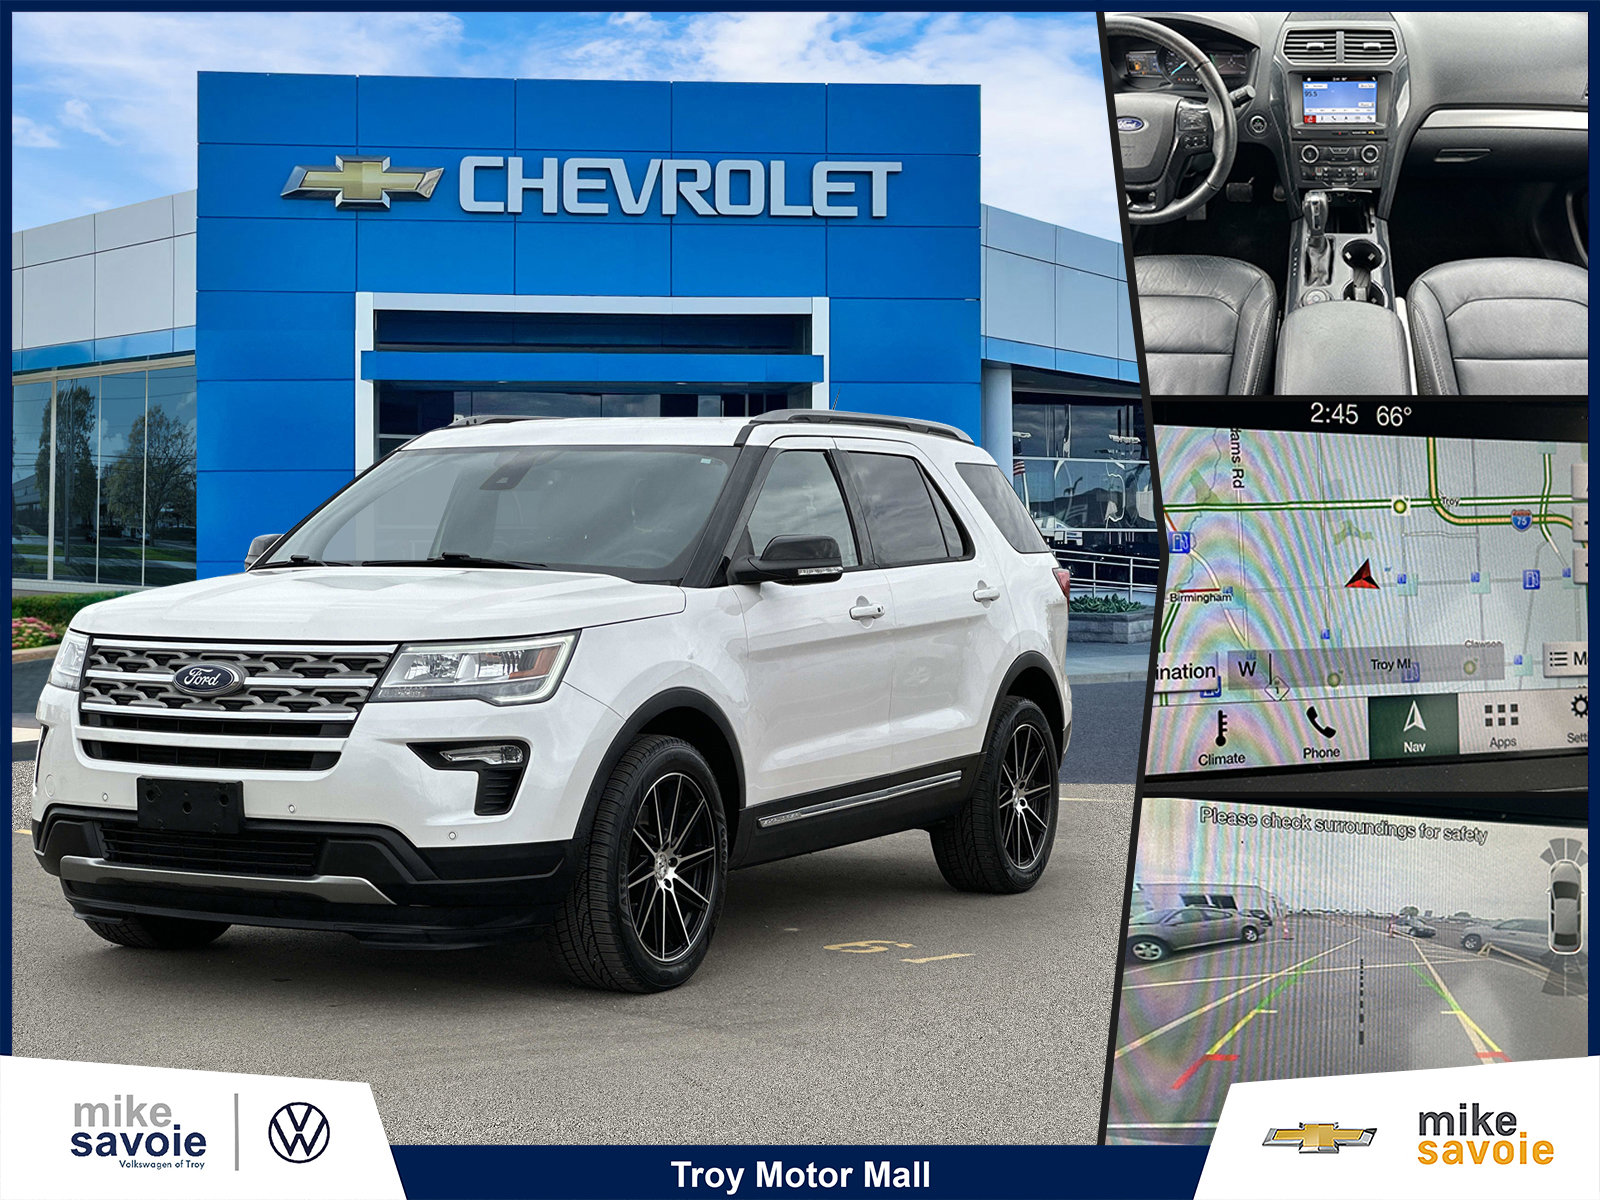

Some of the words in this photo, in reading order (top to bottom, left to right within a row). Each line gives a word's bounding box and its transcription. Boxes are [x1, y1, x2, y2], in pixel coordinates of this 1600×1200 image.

[459, 156, 903, 218] CHEVROLET
[1310, 402, 1359, 424] 2:45
[1376, 406, 1412, 426] 66°
[1232, 468, 1245, 489] Rd
[1442, 496, 1461, 507] Troy
[1169, 593, 1233, 604] Birmingham
[1238, 661, 1257, 678] W
[1371, 658, 1395, 672] Troy
[183, 667, 221, 686] Ford
[1403, 741, 1427, 753] Nav
[1489, 737, 1517, 751] Apps
[1198, 753, 1246, 767] Climate
[1303, 747, 1340, 760] Phone
[1200, 806, 1258, 827] Please
[1260, 812, 1312, 832] check
[1314, 817, 1417, 841] surroundings
[1418, 823, 1441, 840] for
[1442, 827, 1488, 845] safety
